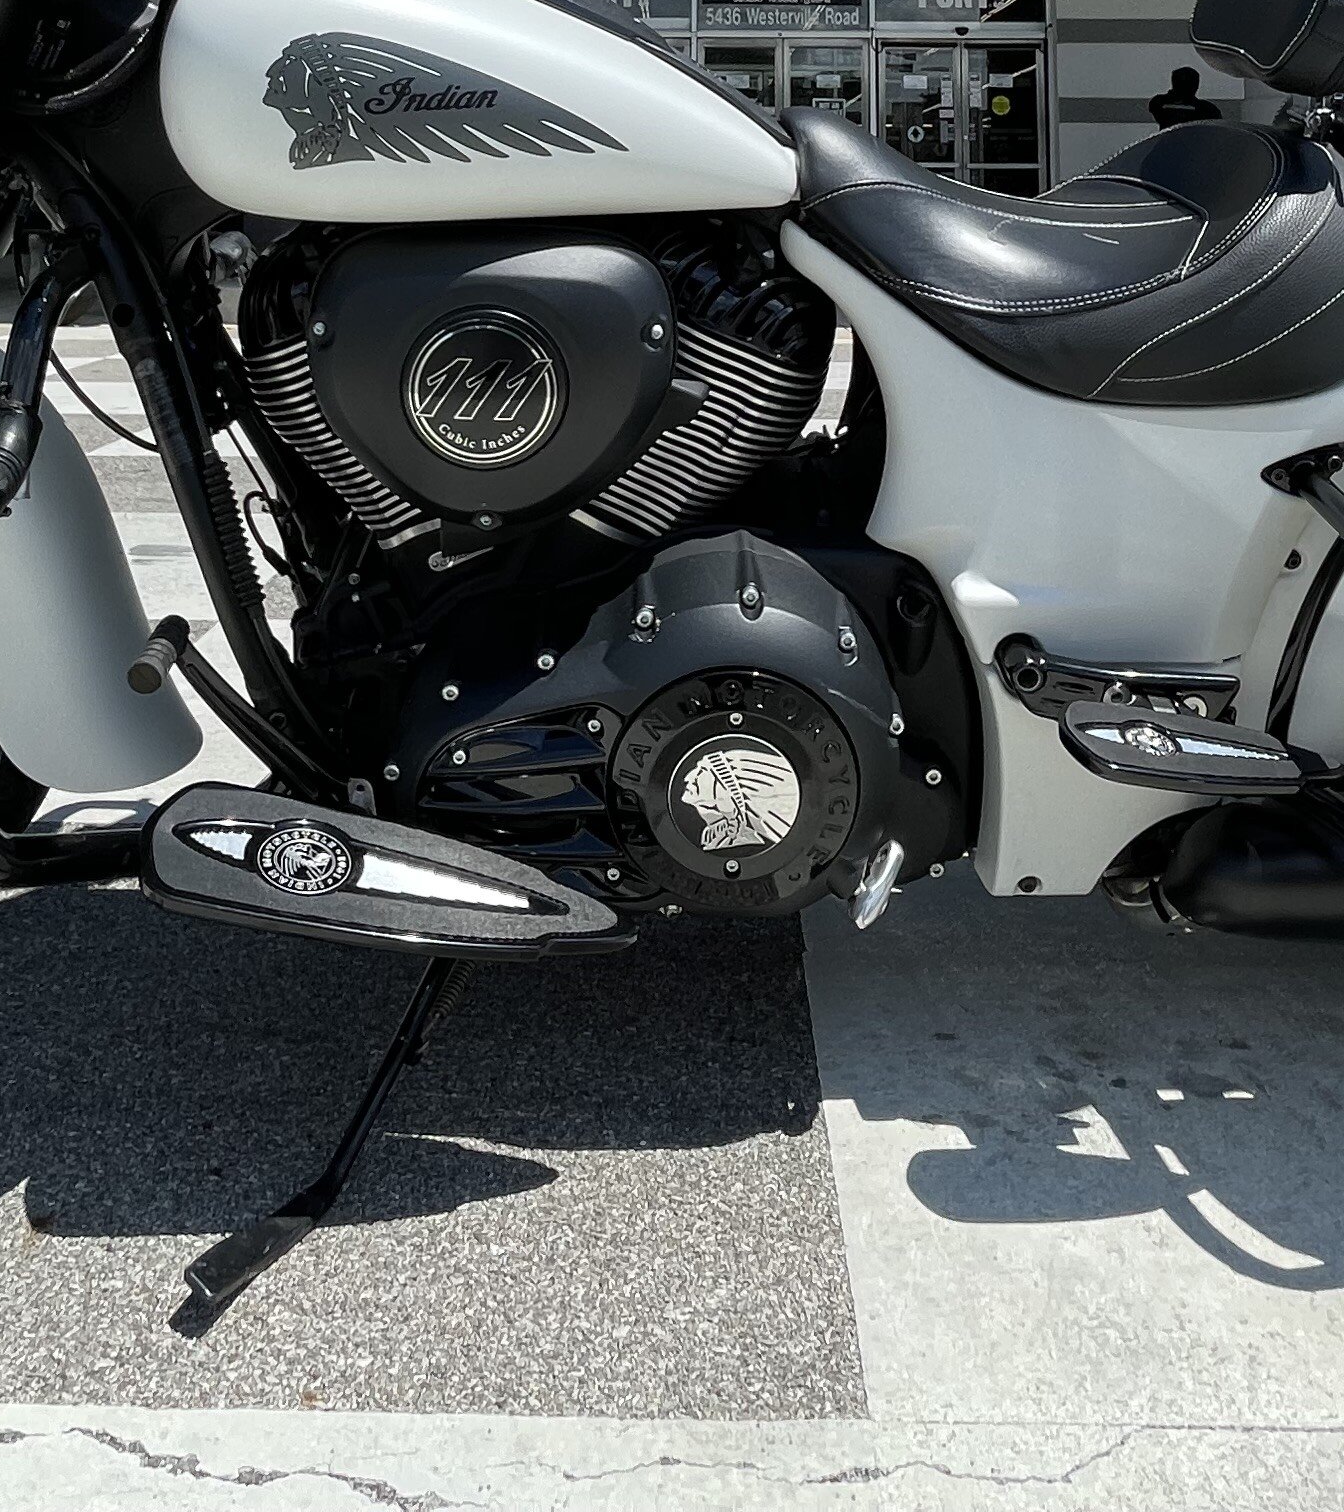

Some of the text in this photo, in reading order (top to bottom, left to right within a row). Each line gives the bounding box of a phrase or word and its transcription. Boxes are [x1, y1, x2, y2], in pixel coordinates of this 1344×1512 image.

[705, 6, 742, 26] 5436
[825, 7, 860, 26] Road
[364, 76, 499, 116] Indian
[415, 357, 554, 421] 111
[438, 423, 527, 451] Cubic Inches
